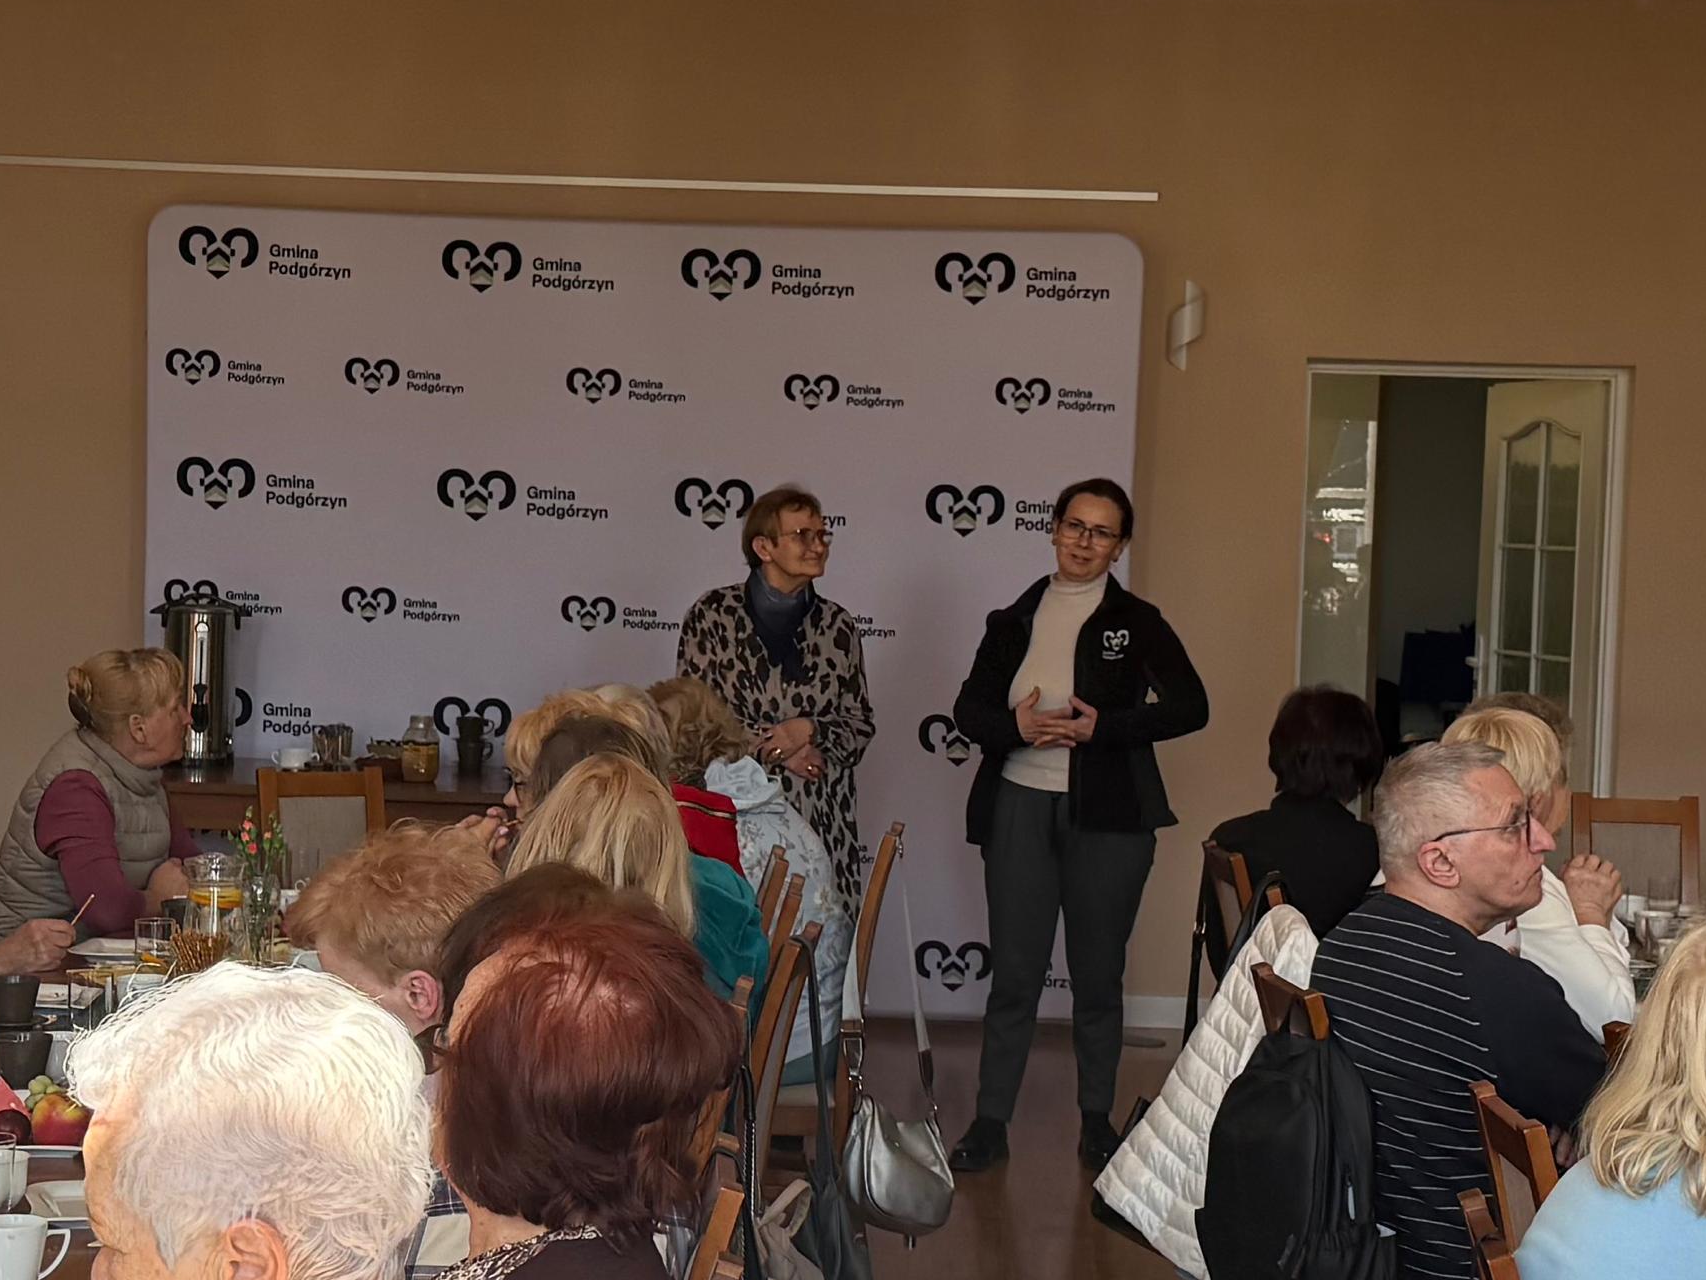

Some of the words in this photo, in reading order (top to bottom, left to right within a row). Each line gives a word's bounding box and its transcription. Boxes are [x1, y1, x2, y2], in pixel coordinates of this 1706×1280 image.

[269, 243, 319, 260] Gmina
[268, 261, 351, 280] Podgórzyn
[532, 257, 582, 272] Gmina
[772, 264, 822, 279] Gmina
[1026, 266, 1077, 281] Gmina
[532, 274, 615, 293] Podgórzyn
[771, 281, 855, 299] Podgórzyn
[1025, 284, 1110, 301] Podgórzyn
[227, 360, 262, 371] Gmina
[227, 372, 285, 386] Podgórzyn
[407, 370, 441, 381] Gmina
[406, 381, 465, 395] Podgórzyn
[628, 378, 663, 389] Gmina
[846, 384, 882, 395] Gmina
[628, 390, 686, 404] Podgórzyn
[1058, 387, 1093, 398] Gmina
[846, 396, 905, 409] Podgórzyn
[1057, 400, 1116, 413] Podgórzyn
[265, 473, 315, 489] Gmina
[526, 485, 576, 501] Gmina
[265, 491, 348, 510] Podgórzyn
[526, 502, 609, 521] Podgórzyn
[225, 590, 260, 601] Gmina
[403, 597, 438, 609] Gmina
[403, 609, 460, 623] Podgórzyn
[622, 607, 658, 618] Gmina
[622, 619, 681, 632] Podgórzyn
[262, 702, 312, 718] Gmina
